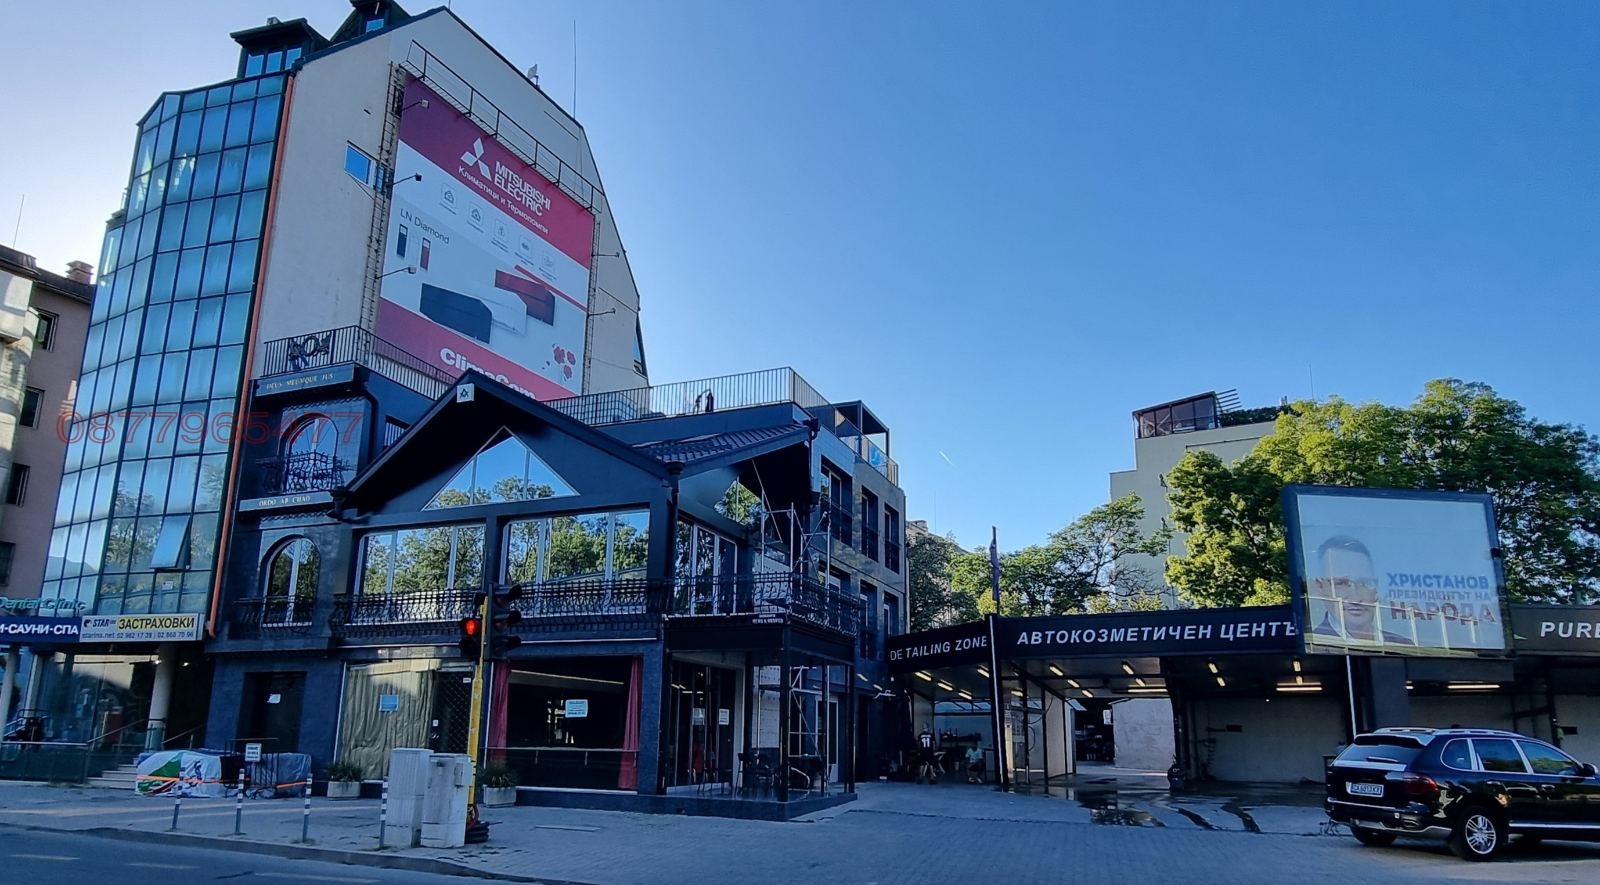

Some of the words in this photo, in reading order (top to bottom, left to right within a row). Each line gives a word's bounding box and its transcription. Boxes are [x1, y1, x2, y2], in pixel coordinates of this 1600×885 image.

[494, 172, 543, 217] ELECTRIC
[495, 160, 551, 211] MITSUBISHI
[458, 165, 500, 202] Климатици
[507, 200, 550, 235] Термопомпи
[400, 208, 412, 223] LN
[414, 216, 450, 245] Diamond
[1386, 573, 1489, 590] ХРИСТАНОВ
[42, 597, 87, 611] Clinic
[1389, 600, 1496, 626] НАРОДА
[118, 617, 195, 630] ЗАСТРАХОВКИ
[1016, 624, 1213, 645] АВТОКОЗМЕТИЧЕН
[955, 635, 988, 651] ZONE
